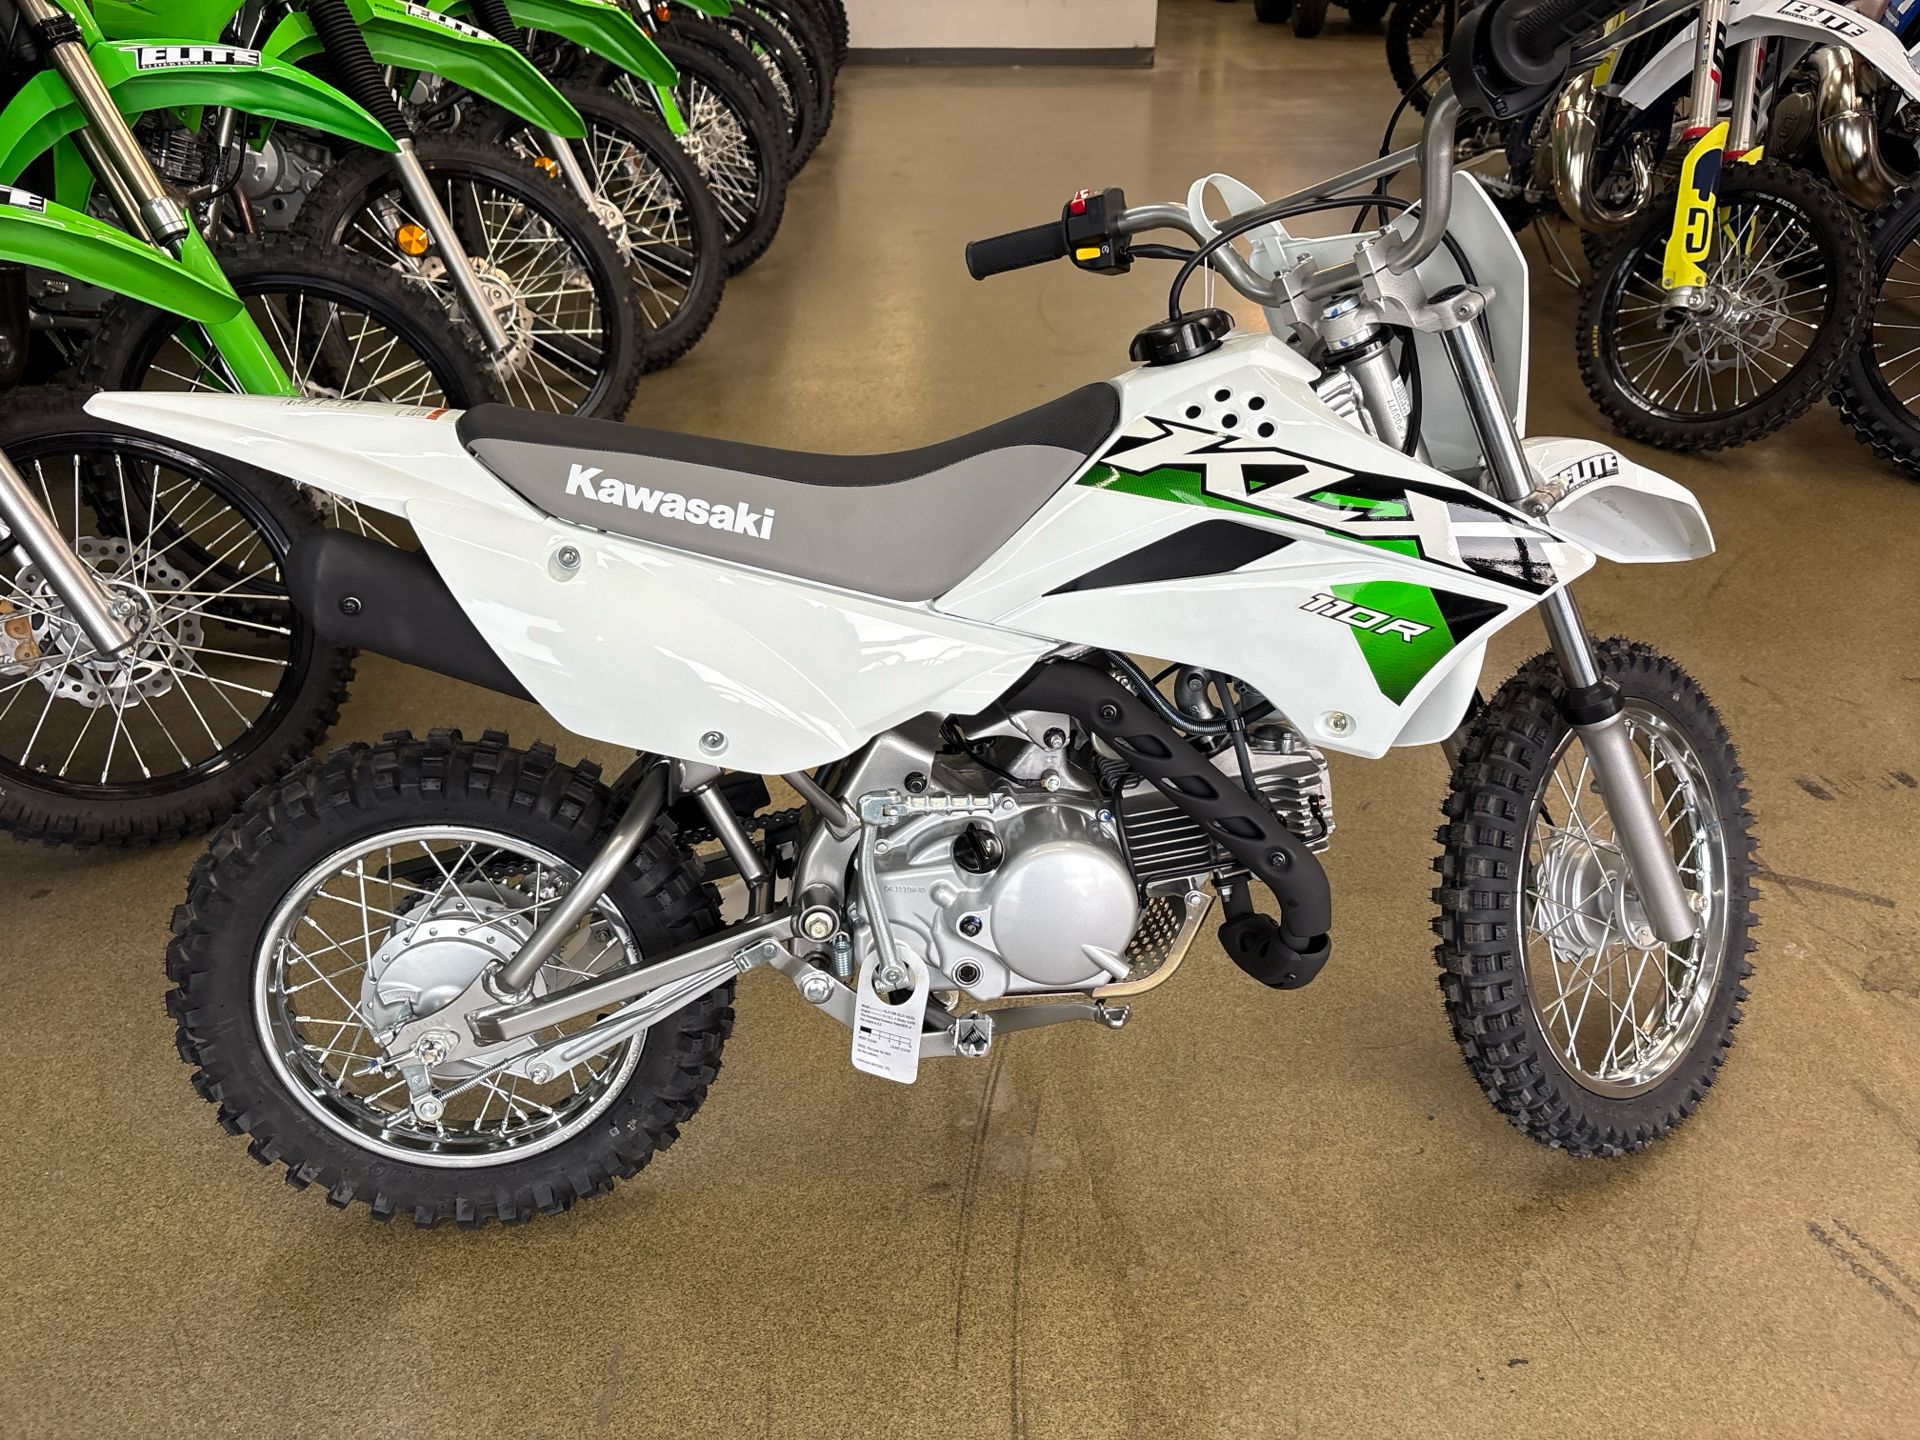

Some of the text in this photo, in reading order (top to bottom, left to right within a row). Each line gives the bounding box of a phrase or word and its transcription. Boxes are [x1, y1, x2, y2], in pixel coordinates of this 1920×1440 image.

[1781, 1, 1865, 37] ELITE
[141, 46, 259, 65] ELITE
[1559, 454, 1617, 490] ELITE
[565, 463, 776, 540] Kawasaki
[1300, 593, 1433, 643] 110R
